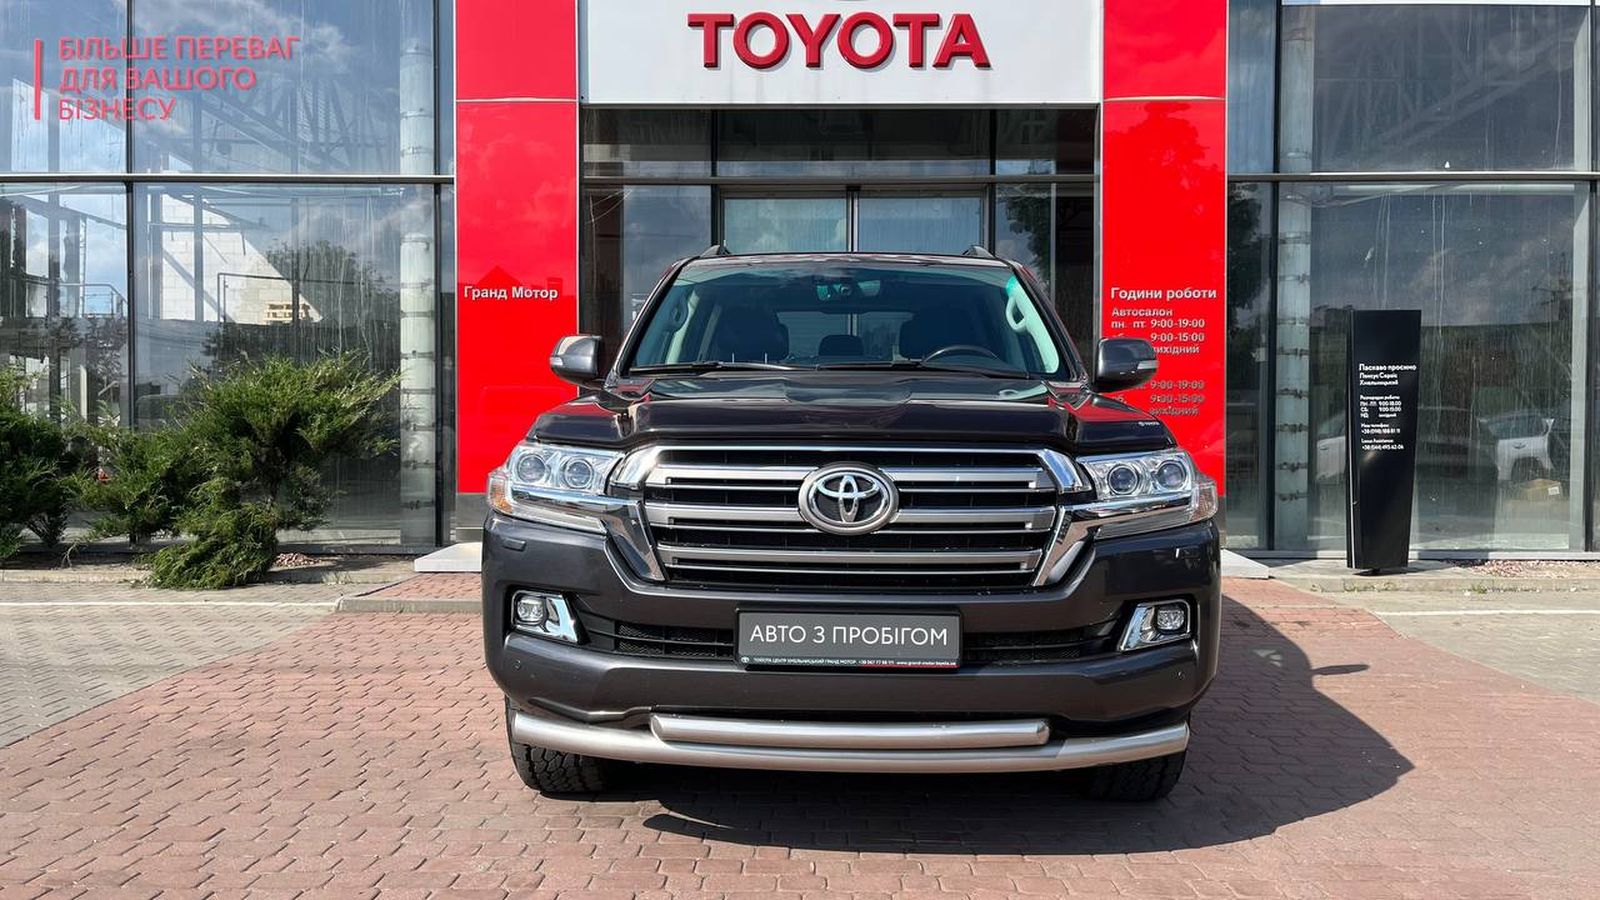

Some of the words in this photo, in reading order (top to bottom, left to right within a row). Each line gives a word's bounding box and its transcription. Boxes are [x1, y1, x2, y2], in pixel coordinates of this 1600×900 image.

[58, 37, 168, 60] БІЛЬШЕ
[175, 35, 301, 60] ПЕРЕВАГ
[687, 11, 991, 69] TOYOTA
[58, 67, 118, 92] ДЛЯ
[127, 66, 257, 91] ВАШОГО
[58, 97, 177, 121] БІЗНЕСУ
[464, 285, 508, 301] Гранд
[511, 286, 559, 301] Мотор
[1110, 287, 1162, 301] Години
[1166, 286, 1217, 301] роботи
[1111, 308, 1173, 317] Автосалон
[750, 625, 806, 643] АВТО
[813, 626, 825, 643] З
[833, 626, 948, 646] ПРОБІГОМ
